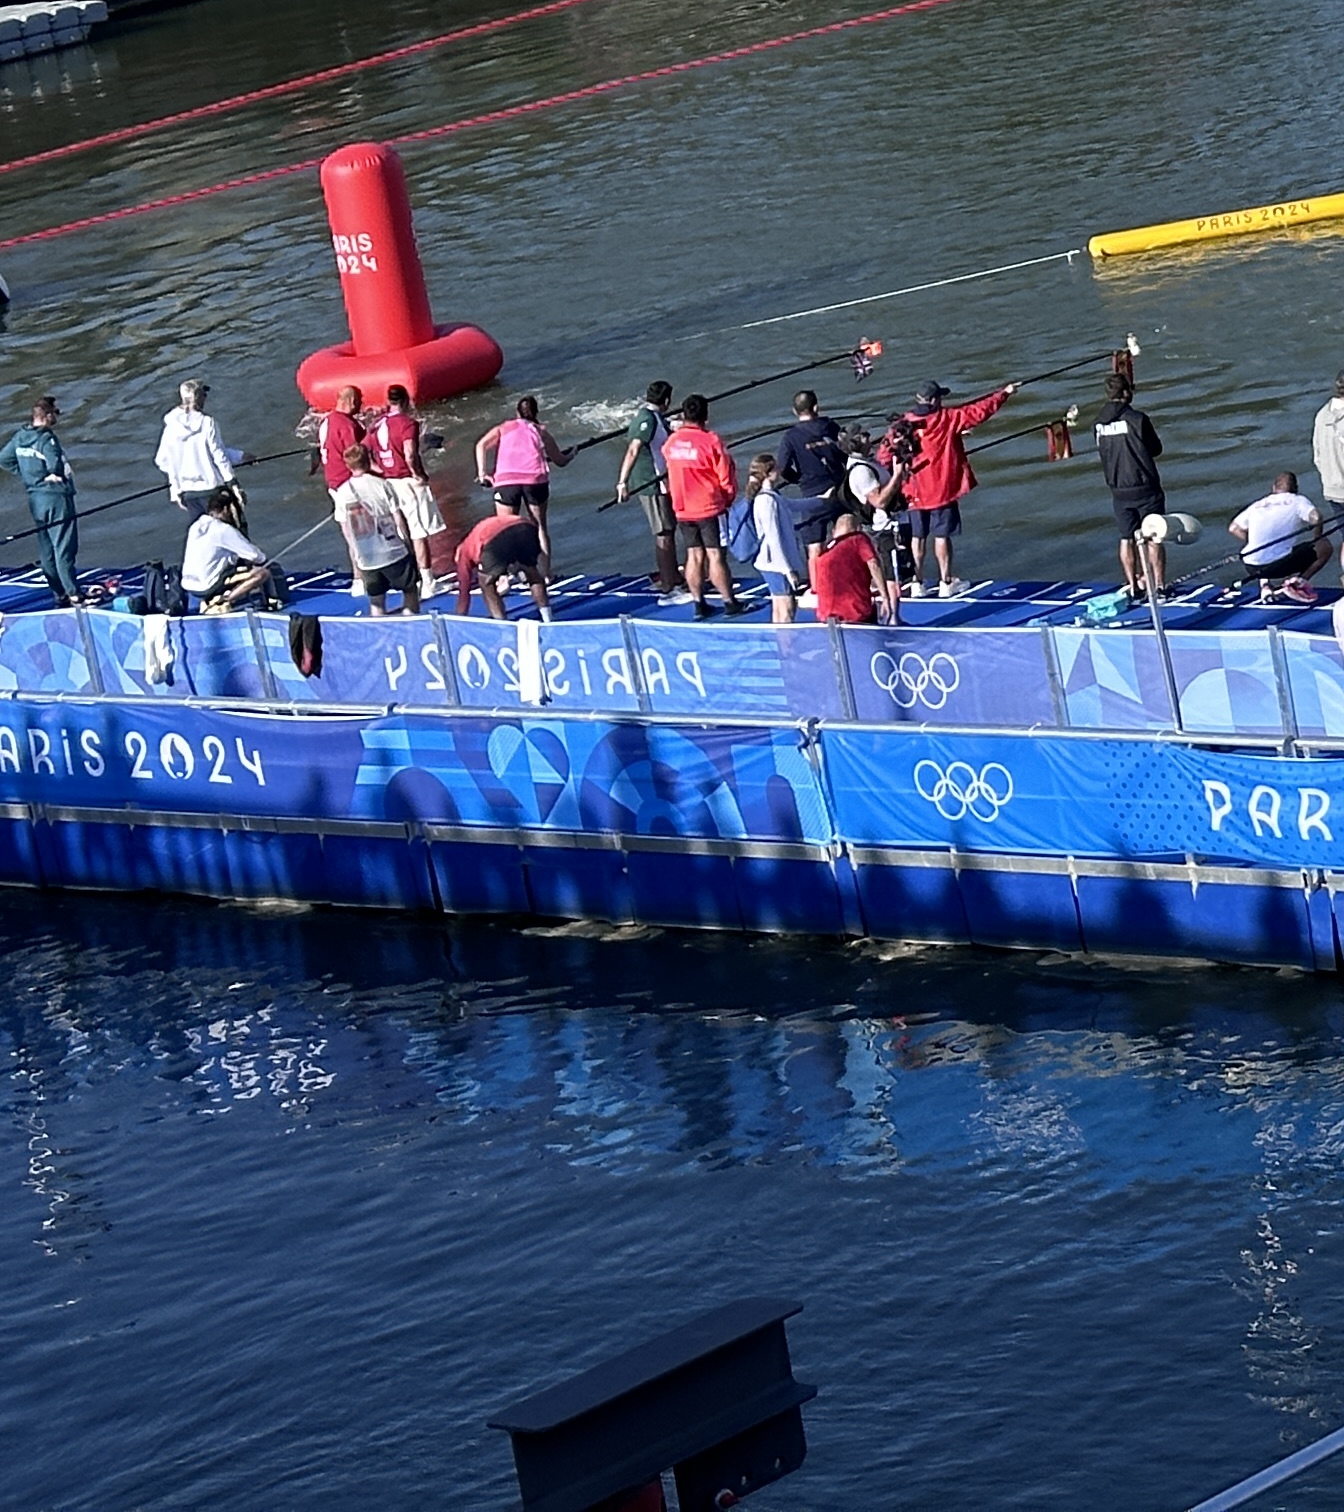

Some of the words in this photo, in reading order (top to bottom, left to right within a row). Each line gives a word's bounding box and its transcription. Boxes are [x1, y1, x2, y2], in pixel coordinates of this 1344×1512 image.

[1197, 212, 1253, 231] PARIS
[1260, 203, 1311, 221] 2024
[333, 233, 373, 254] RIS
[337, 254, 378, 274] 024
[0, 726, 105, 777] ARIS
